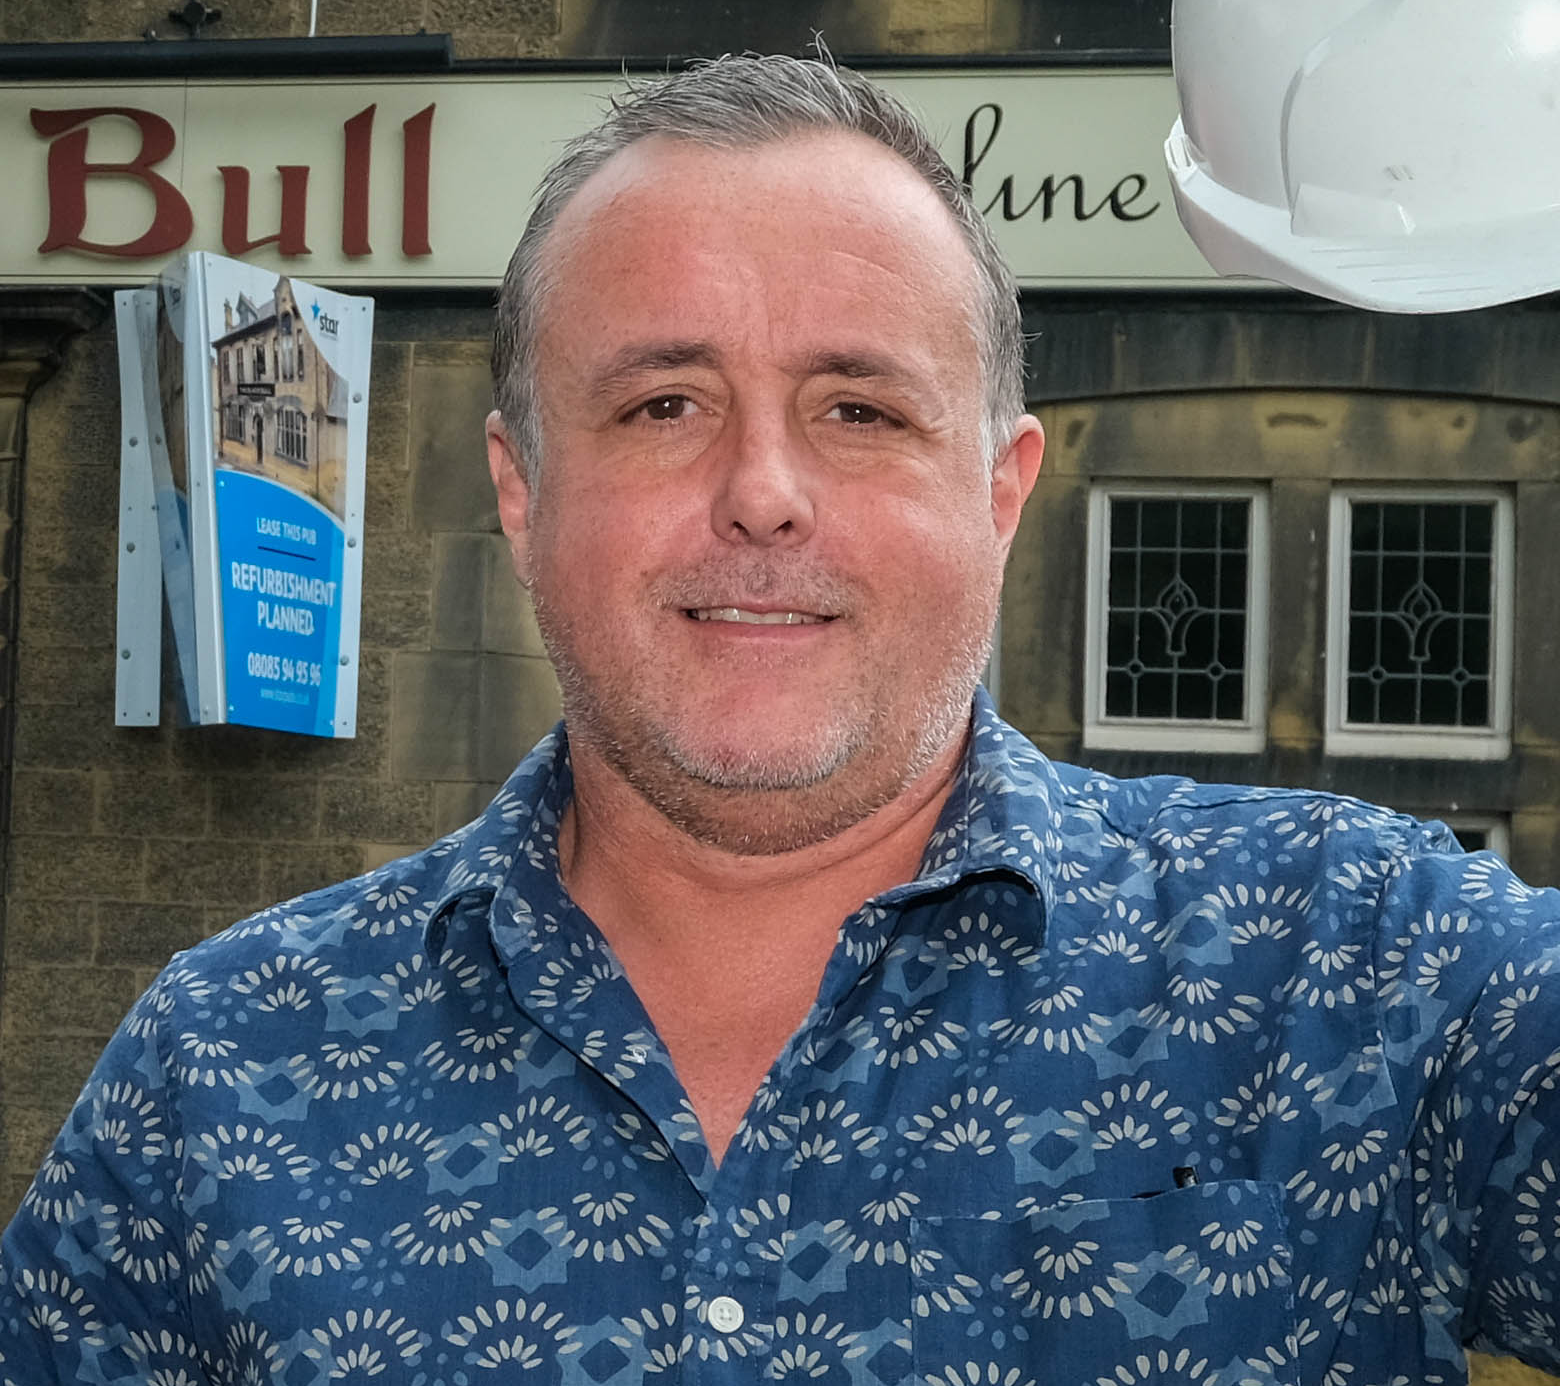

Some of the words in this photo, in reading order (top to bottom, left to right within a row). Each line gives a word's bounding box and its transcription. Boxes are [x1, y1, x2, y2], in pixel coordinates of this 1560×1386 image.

[30, 103, 437, 259] Bull
[319, 313, 339, 334] star
[256, 517, 281, 537] LEASE
[282, 522, 301, 542] THIS
[301, 526, 317, 545] PUB
[231, 561, 336, 608] REFURBISHMENT
[257, 600, 314, 636] PLANNED
[247, 651, 281, 681] 08085
[281, 657, 295, 682] 94
[296, 660, 309, 685] 95
